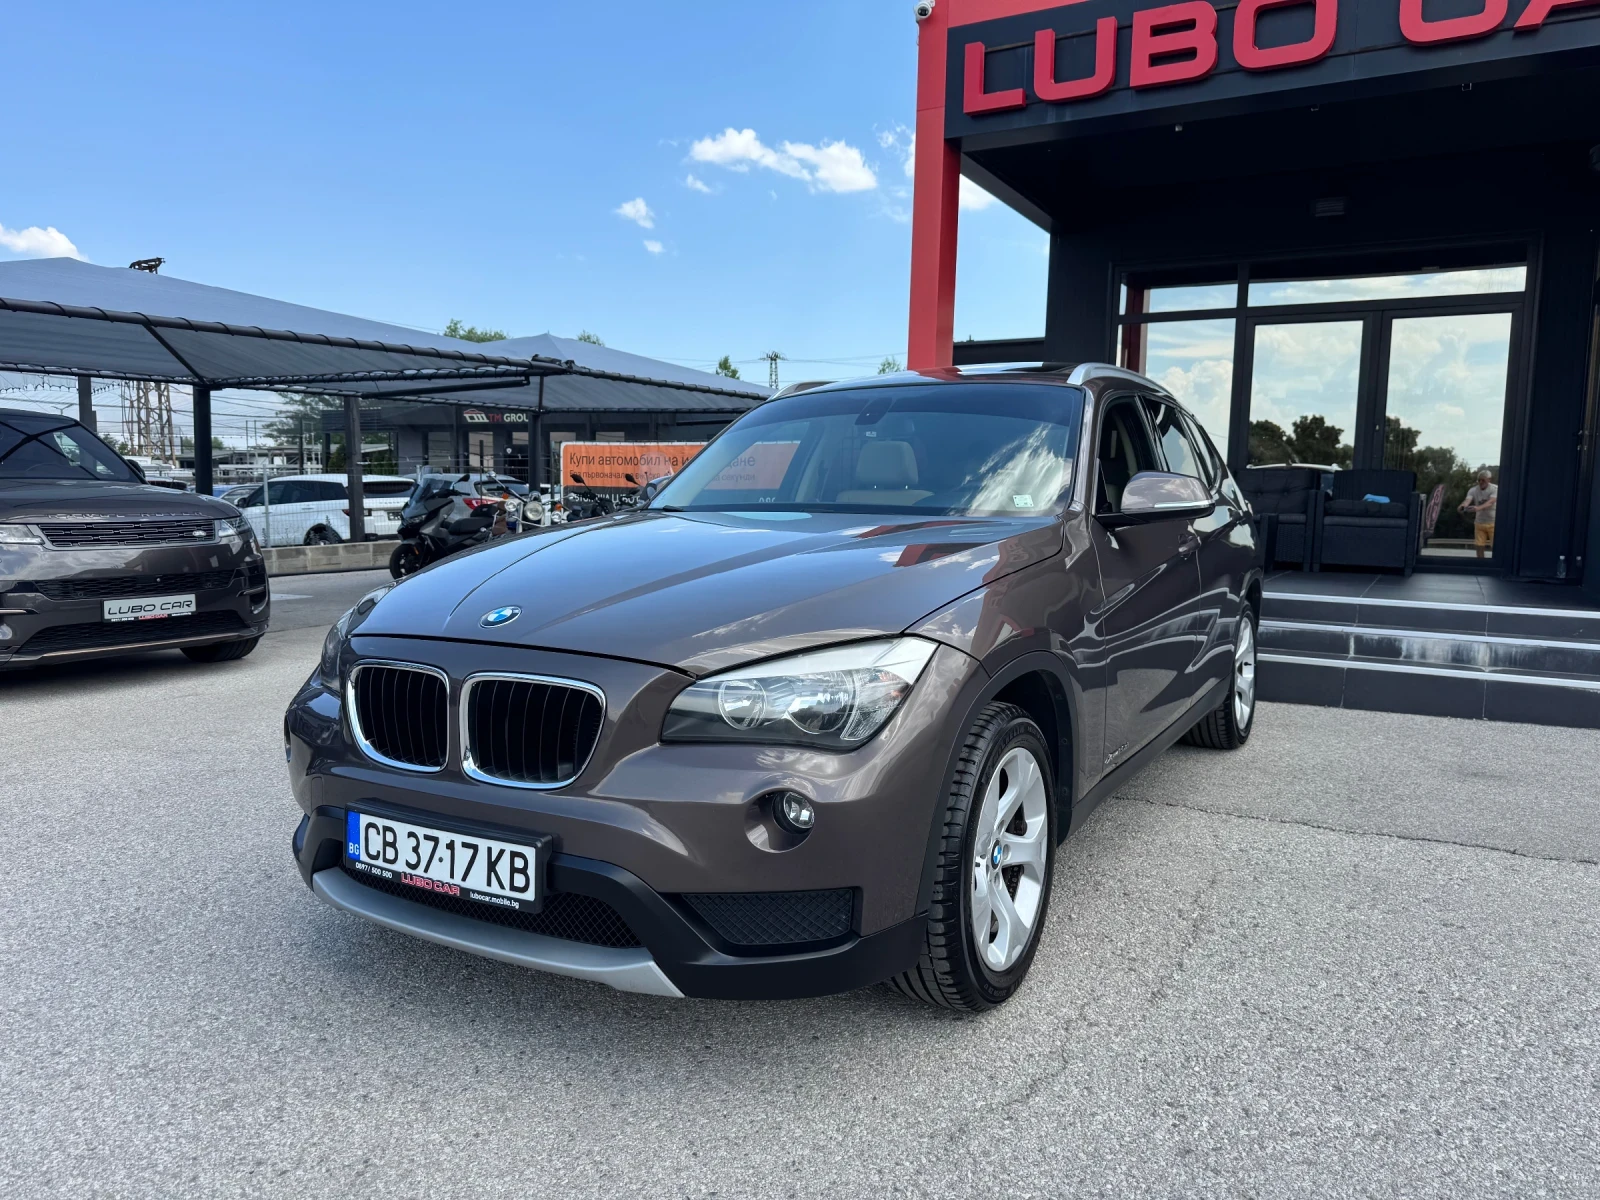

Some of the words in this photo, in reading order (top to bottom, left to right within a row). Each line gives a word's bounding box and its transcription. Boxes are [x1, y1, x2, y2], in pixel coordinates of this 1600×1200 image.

[963, 0, 1336, 117] LUBO
[488, 413, 502, 422] TM
[503, 413, 529, 422] GROU
[569, 453, 595, 467] Купи
[598, 454, 661, 466] автомобил
[664, 455, 679, 466] на
[107, 604, 156, 615] LUBO
[160, 600, 193, 611] CAR
[348, 842, 360, 856] BG
[401, 872, 433, 890] LUBO
[433, 881, 460, 897] CAR
[470, 891, 520, 910] lubocar.mobile.bg
